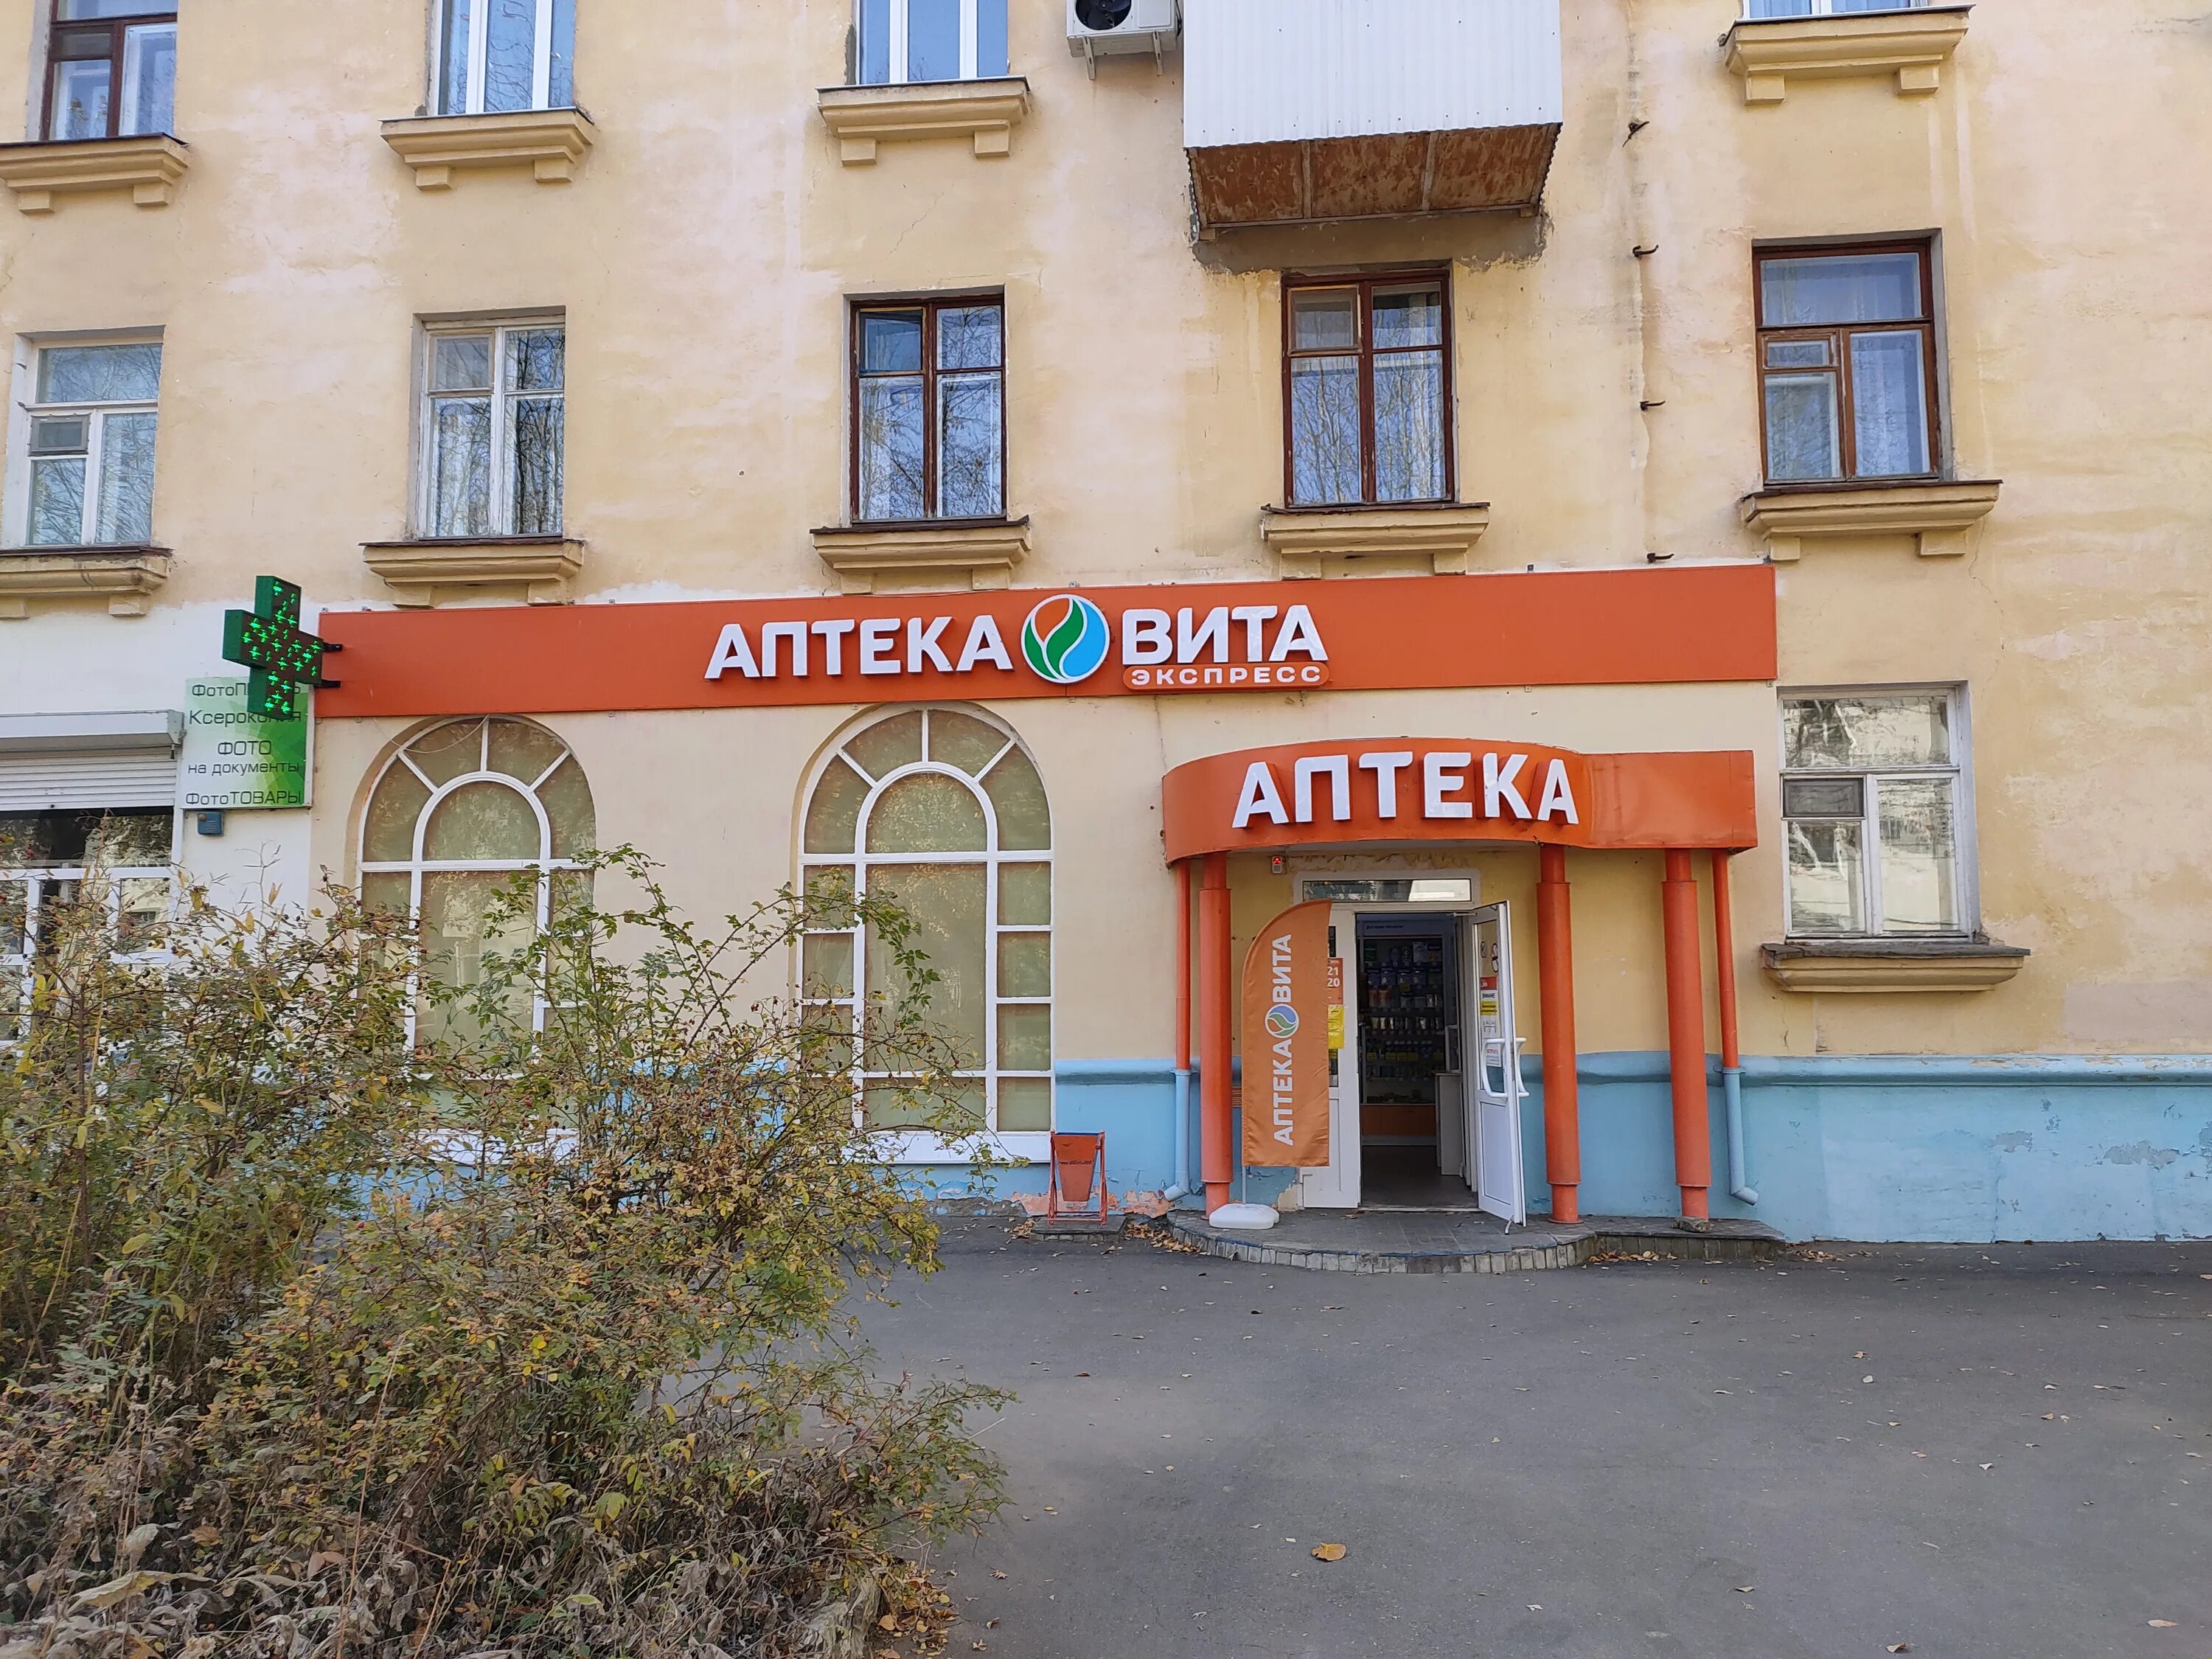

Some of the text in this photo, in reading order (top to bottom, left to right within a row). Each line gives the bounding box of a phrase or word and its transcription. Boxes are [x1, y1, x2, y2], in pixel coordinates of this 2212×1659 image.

[705, 605, 1328, 679] АПТЕКА ВИТА
[1132, 667, 1320, 685] ЭКСПРЕСС
[188, 762, 299, 776] на документы
[218, 740, 272, 756] ФОТО
[1232, 751, 1579, 828] АПТЕКА
[1272, 934, 1293, 1146] АПТЕКА ВИТА
